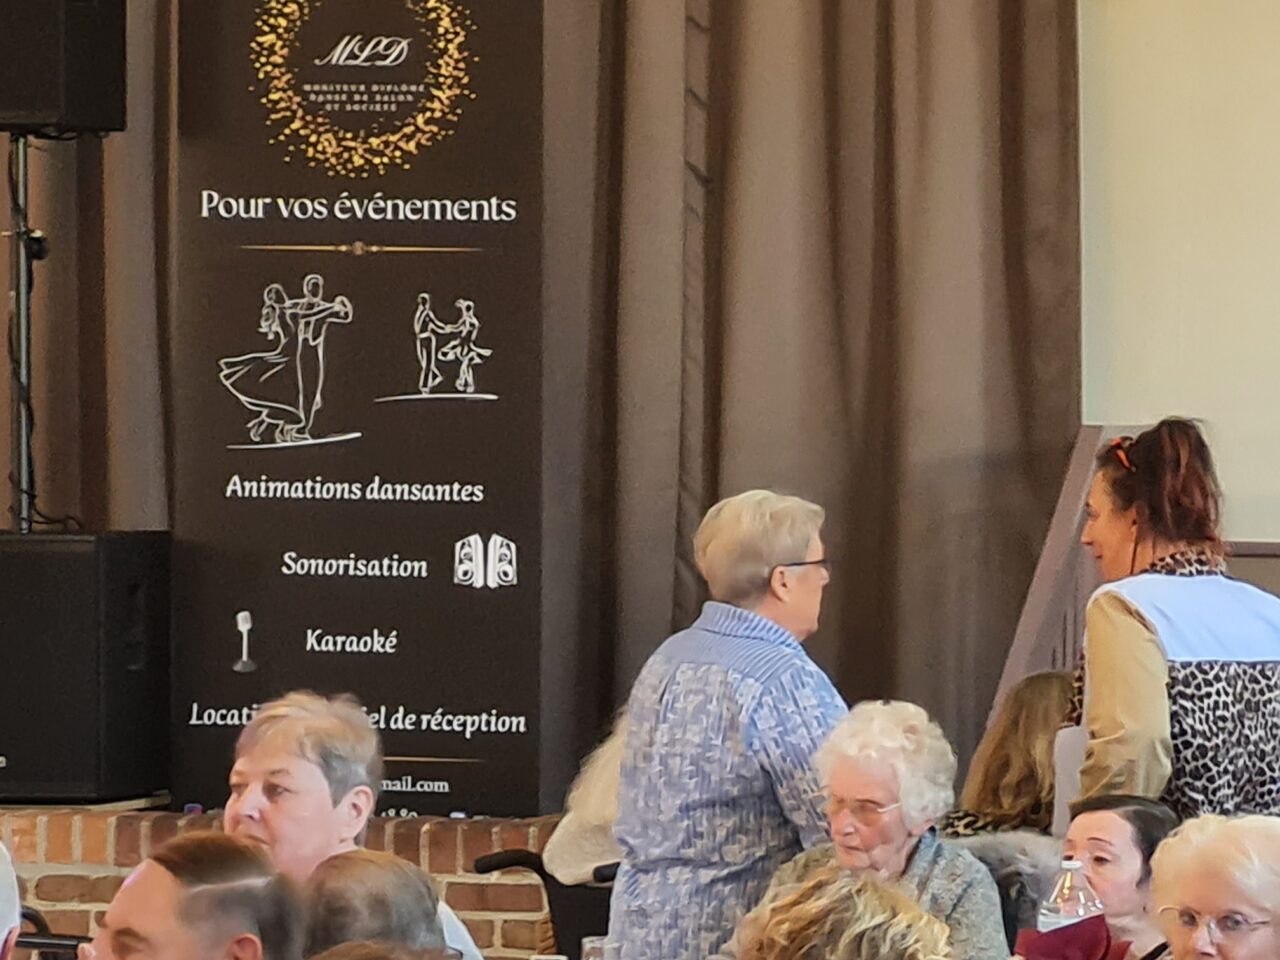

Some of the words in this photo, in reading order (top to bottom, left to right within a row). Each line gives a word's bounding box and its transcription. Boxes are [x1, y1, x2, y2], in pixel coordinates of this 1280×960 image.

[313, 34, 413, 67] MLD
[200, 190, 273, 219] Pour
[276, 197, 328, 220] vos
[333, 191, 518, 222] événements
[225, 474, 362, 501] Animations
[364, 475, 485, 503] dansantes
[281, 551, 429, 579] Sonorisation
[305, 628, 399, 654] Karaoké
[188, 702, 260, 726] Locati
[389, 705, 417, 730] de
[420, 707, 527, 739] réception
